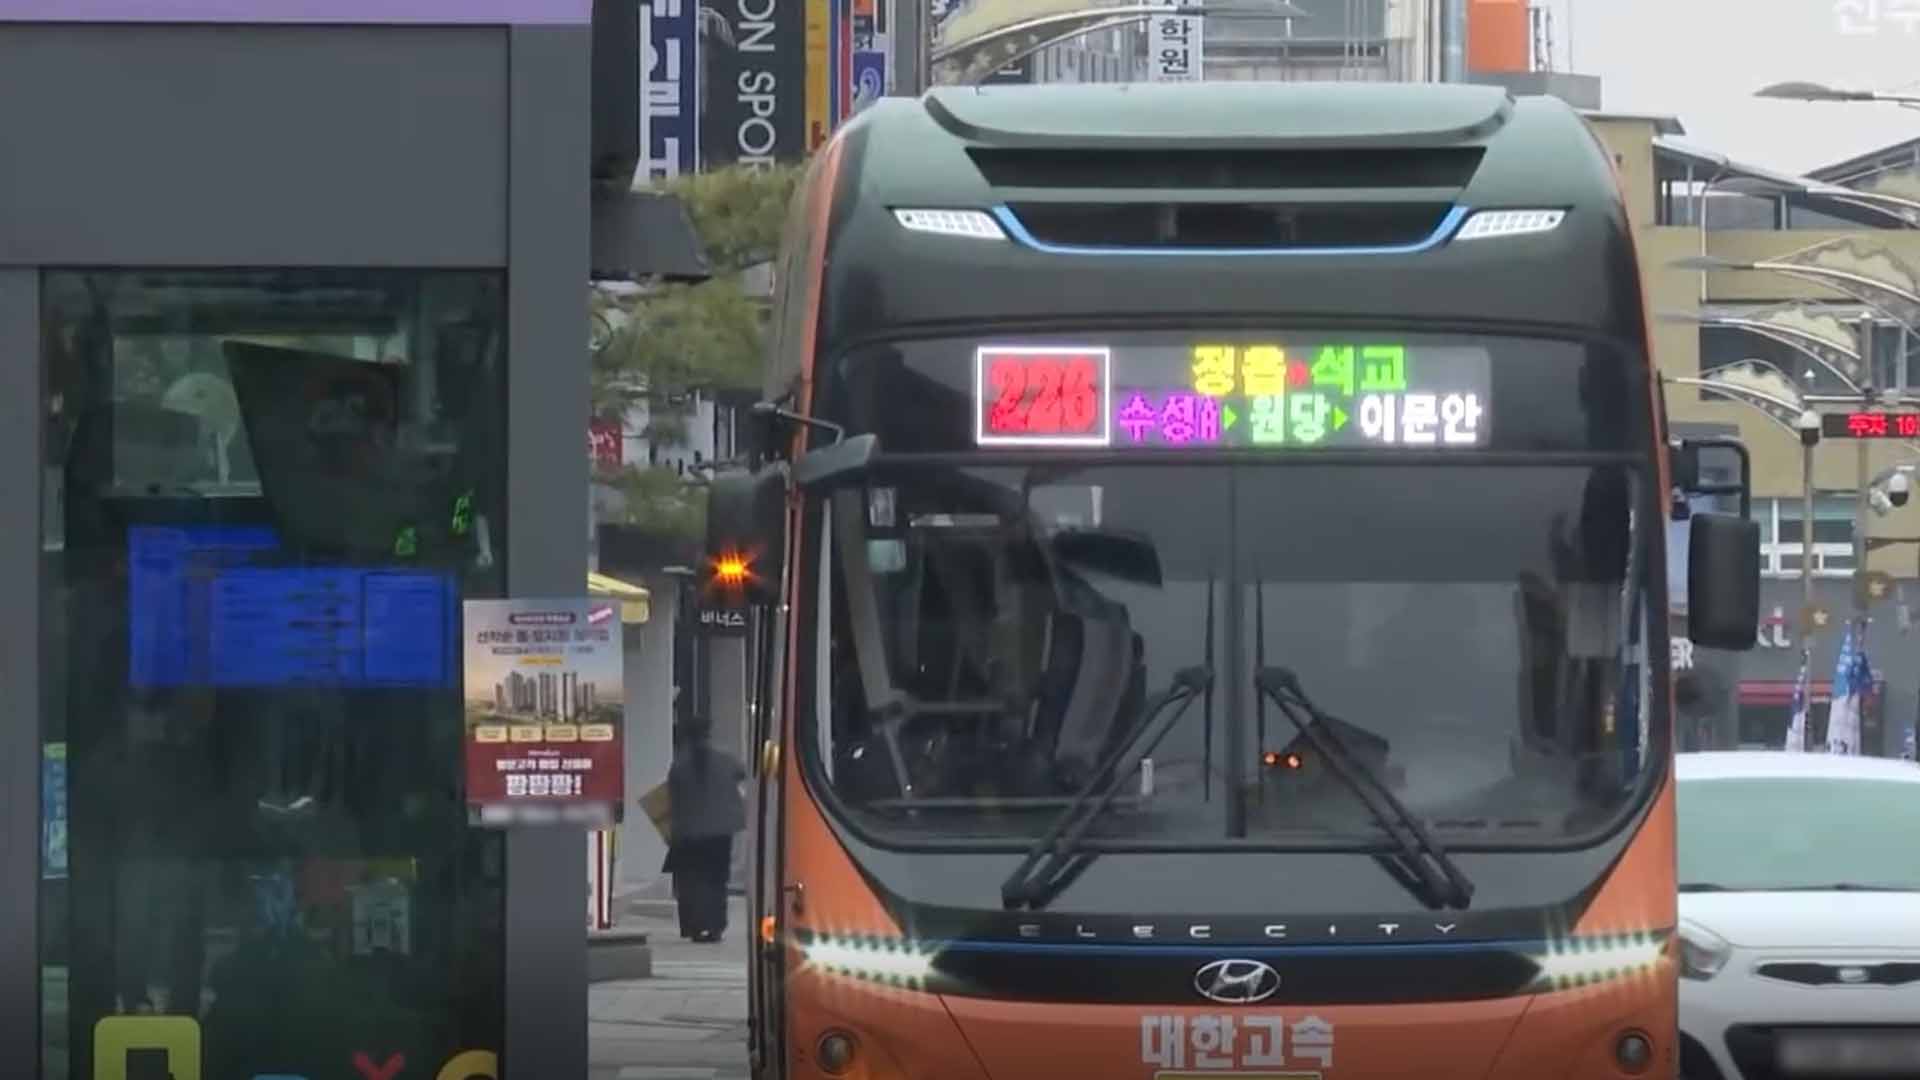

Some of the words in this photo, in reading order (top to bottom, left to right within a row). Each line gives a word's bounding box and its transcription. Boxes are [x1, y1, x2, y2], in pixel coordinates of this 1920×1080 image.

[1160, 0, 1191, 75] 학원
[990, 358, 1097, 434] 226
[1250, 393, 1331, 443] 원당
[1360, 393, 1482, 443] 이문안
[1896, 415, 1920, 435] 10
[702, 611, 745, 626] 비너스
[1020, 924, 1211, 938] ELEC
[1265, 923, 1456, 938] CITY
[1141, 1015, 1334, 1067] 대한고속
